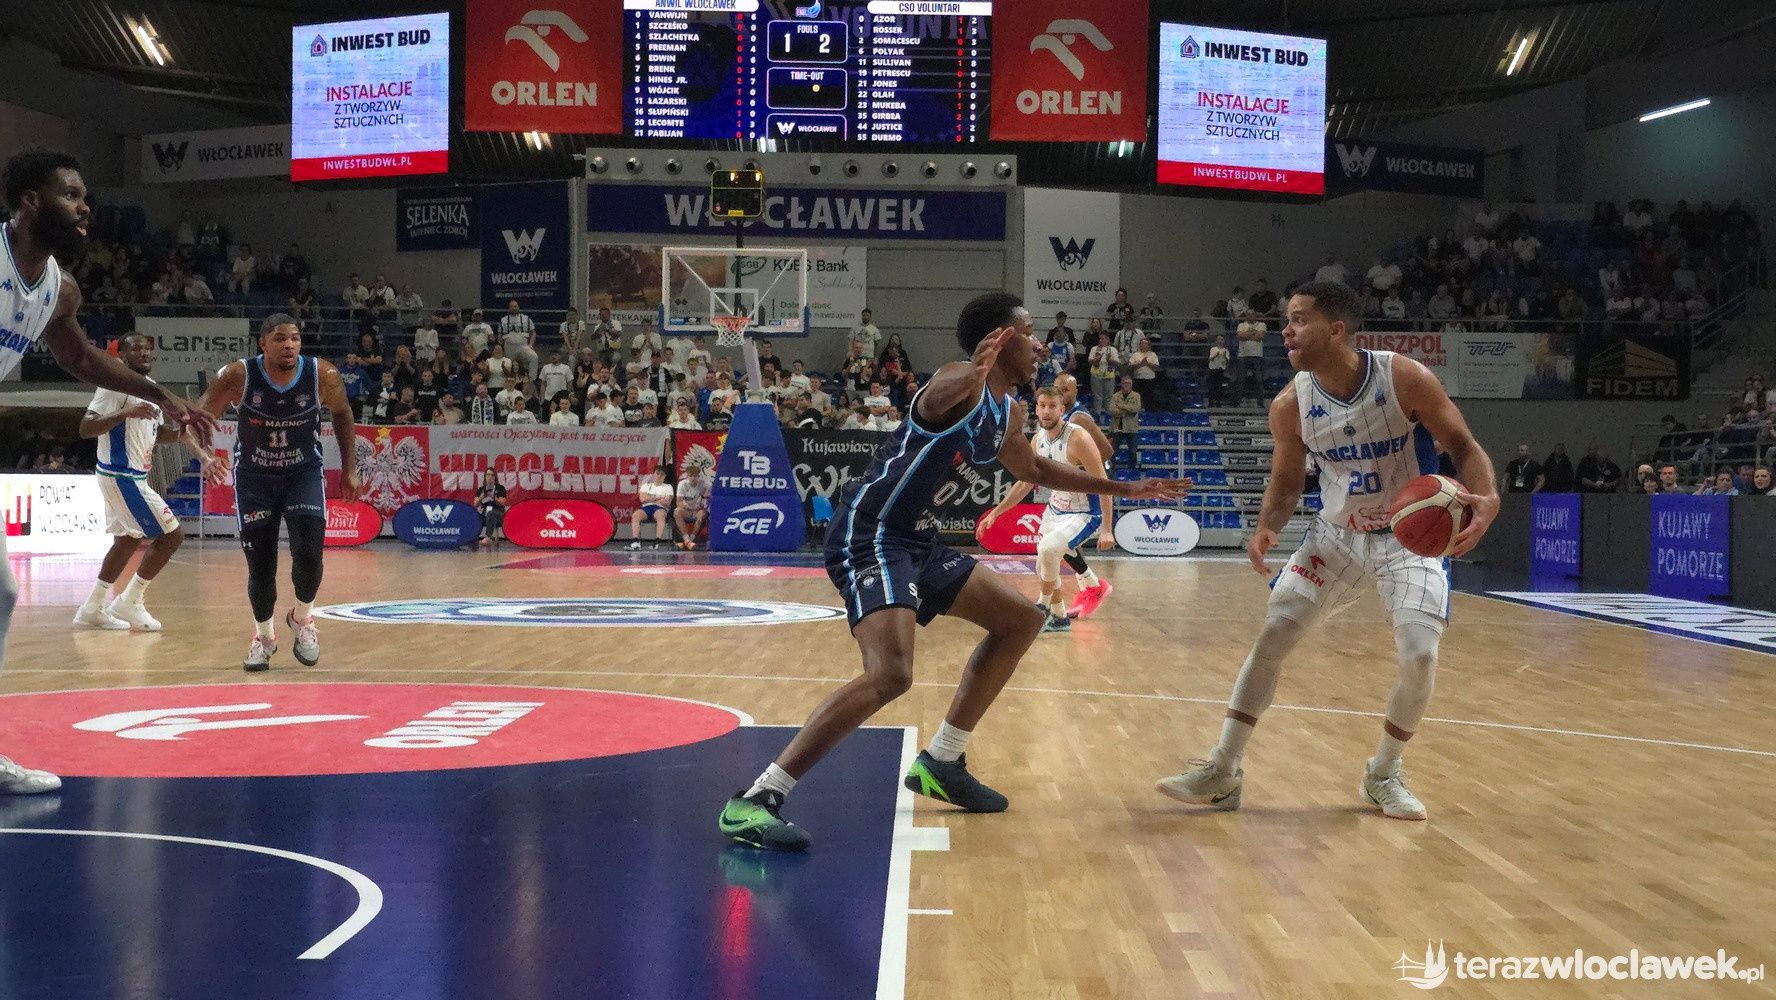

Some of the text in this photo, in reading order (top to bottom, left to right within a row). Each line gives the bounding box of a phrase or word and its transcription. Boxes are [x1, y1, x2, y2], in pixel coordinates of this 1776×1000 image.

[899, 3, 960, 13] CSO VOLUNTARI
[635, 11, 641, 19] 0
[648, 11, 688, 20] VANWIJN
[858, 15, 865, 23] 0
[873, 15, 896, 23] AZOR
[635, 21, 640, 29] 1
[797, 25, 819, 34] FOULS
[858, 26, 864, 34] 1
[873, 26, 903, 34] ROSSER
[332, 29, 431, 52] INWEST BUD
[635, 32, 641, 40] 4
[648, 33, 700, 42] SZLACHETKA
[784, 33, 831, 53] 1 2
[872, 37, 921, 45] SOMACESCU
[635, 43, 641, 51] 5
[648, 43, 687, 52] FREEMAN
[858, 47, 864, 55] 6
[873, 47, 905, 56] POLYAK
[1205, 41, 1309, 66] INWEST BUD
[635, 54, 641, 62] 6
[648, 54, 676, 62] EDWIN
[858, 58, 867, 66] 11
[872, 58, 912, 67] SULLIVAN
[634, 64, 641, 72] 7
[648, 65, 676, 73] BRENK
[858, 69, 868, 77] 19
[872, 69, 911, 77] PETRESCU
[648, 76, 673, 84] HINES
[675, 76, 688, 84] JR.
[790, 71, 825, 81] TIME-OUT
[634, 86, 641, 94] 9
[648, 85, 680, 95] WÓJCIK
[872, 80, 898, 88] JONES
[326, 81, 413, 102] INSTALACJE
[491, 80, 598, 107] ORLEN
[857, 90, 868, 98] 22
[872, 91, 895, 99] OLAH
[335, 100, 401, 115] Z TWORZYW
[634, 97, 643, 105] 11
[857, 101, 868, 109] 23
[872, 101, 907, 110] MUKEBA
[1016, 89, 1122, 115] ORLEN
[1198, 91, 1290, 115] INSTALACJE
[634, 108, 644, 116] 16
[857, 112, 868, 120] 35
[1206, 110, 1277, 127] Z TWORZYW
[334, 114, 404, 129] SZTUCZNYCH
[634, 118, 645, 126] 20
[648, 119, 684, 127] LECOMTE
[857, 122, 868, 130] 44
[871, 123, 903, 131] JUSTICE
[634, 129, 644, 137] 21
[647, 129, 683, 138] PABIJAN
[857, 133, 867, 141] 55
[871, 133, 903, 142] DURMO
[1206, 125, 1280, 141] SZTUCZNYCH
[198, 142, 284, 162] WŁOCŁAWEK
[323, 156, 412, 170] INWESTBUDWL.PL
[1385, 156, 1475, 179] WŁOCŁAWEK
[1193, 167, 1288, 183] INWESTBUDWL.PL
[406, 204, 470, 229] SELENKA
[817, 259, 849, 272] Bank
[491, 270, 558, 285] WŁOCŁAWEK
[1036, 279, 1107, 292] WŁOCŁAWEK
[1586, 378, 1679, 397] FIDEM
[268, 430, 289, 448] 11
[450, 428, 500, 440] wartości
[559, 429, 579, 442] jest
[582, 432, 597, 441] na
[800, 437, 879, 456] Kujawiacy
[719, 476, 788, 490] TERBUD
[1349, 471, 1383, 496] 20
[1536, 507, 1570, 531] KUJAWY
[1658, 511, 1712, 540] KUJAWY
[413, 527, 461, 535] WŁOCŁAWEK
[722, 517, 773, 535] PGE
[540, 529, 577, 538] ORLEN
[1134, 535, 1180, 545] WŁOCŁAWEK
[1535, 537, 1577, 564] POMORZE
[1657, 547, 1724, 580] POMORZE
[1290, 564, 1325, 588] ORLEN
[363, 700, 546, 749] ORLEN
